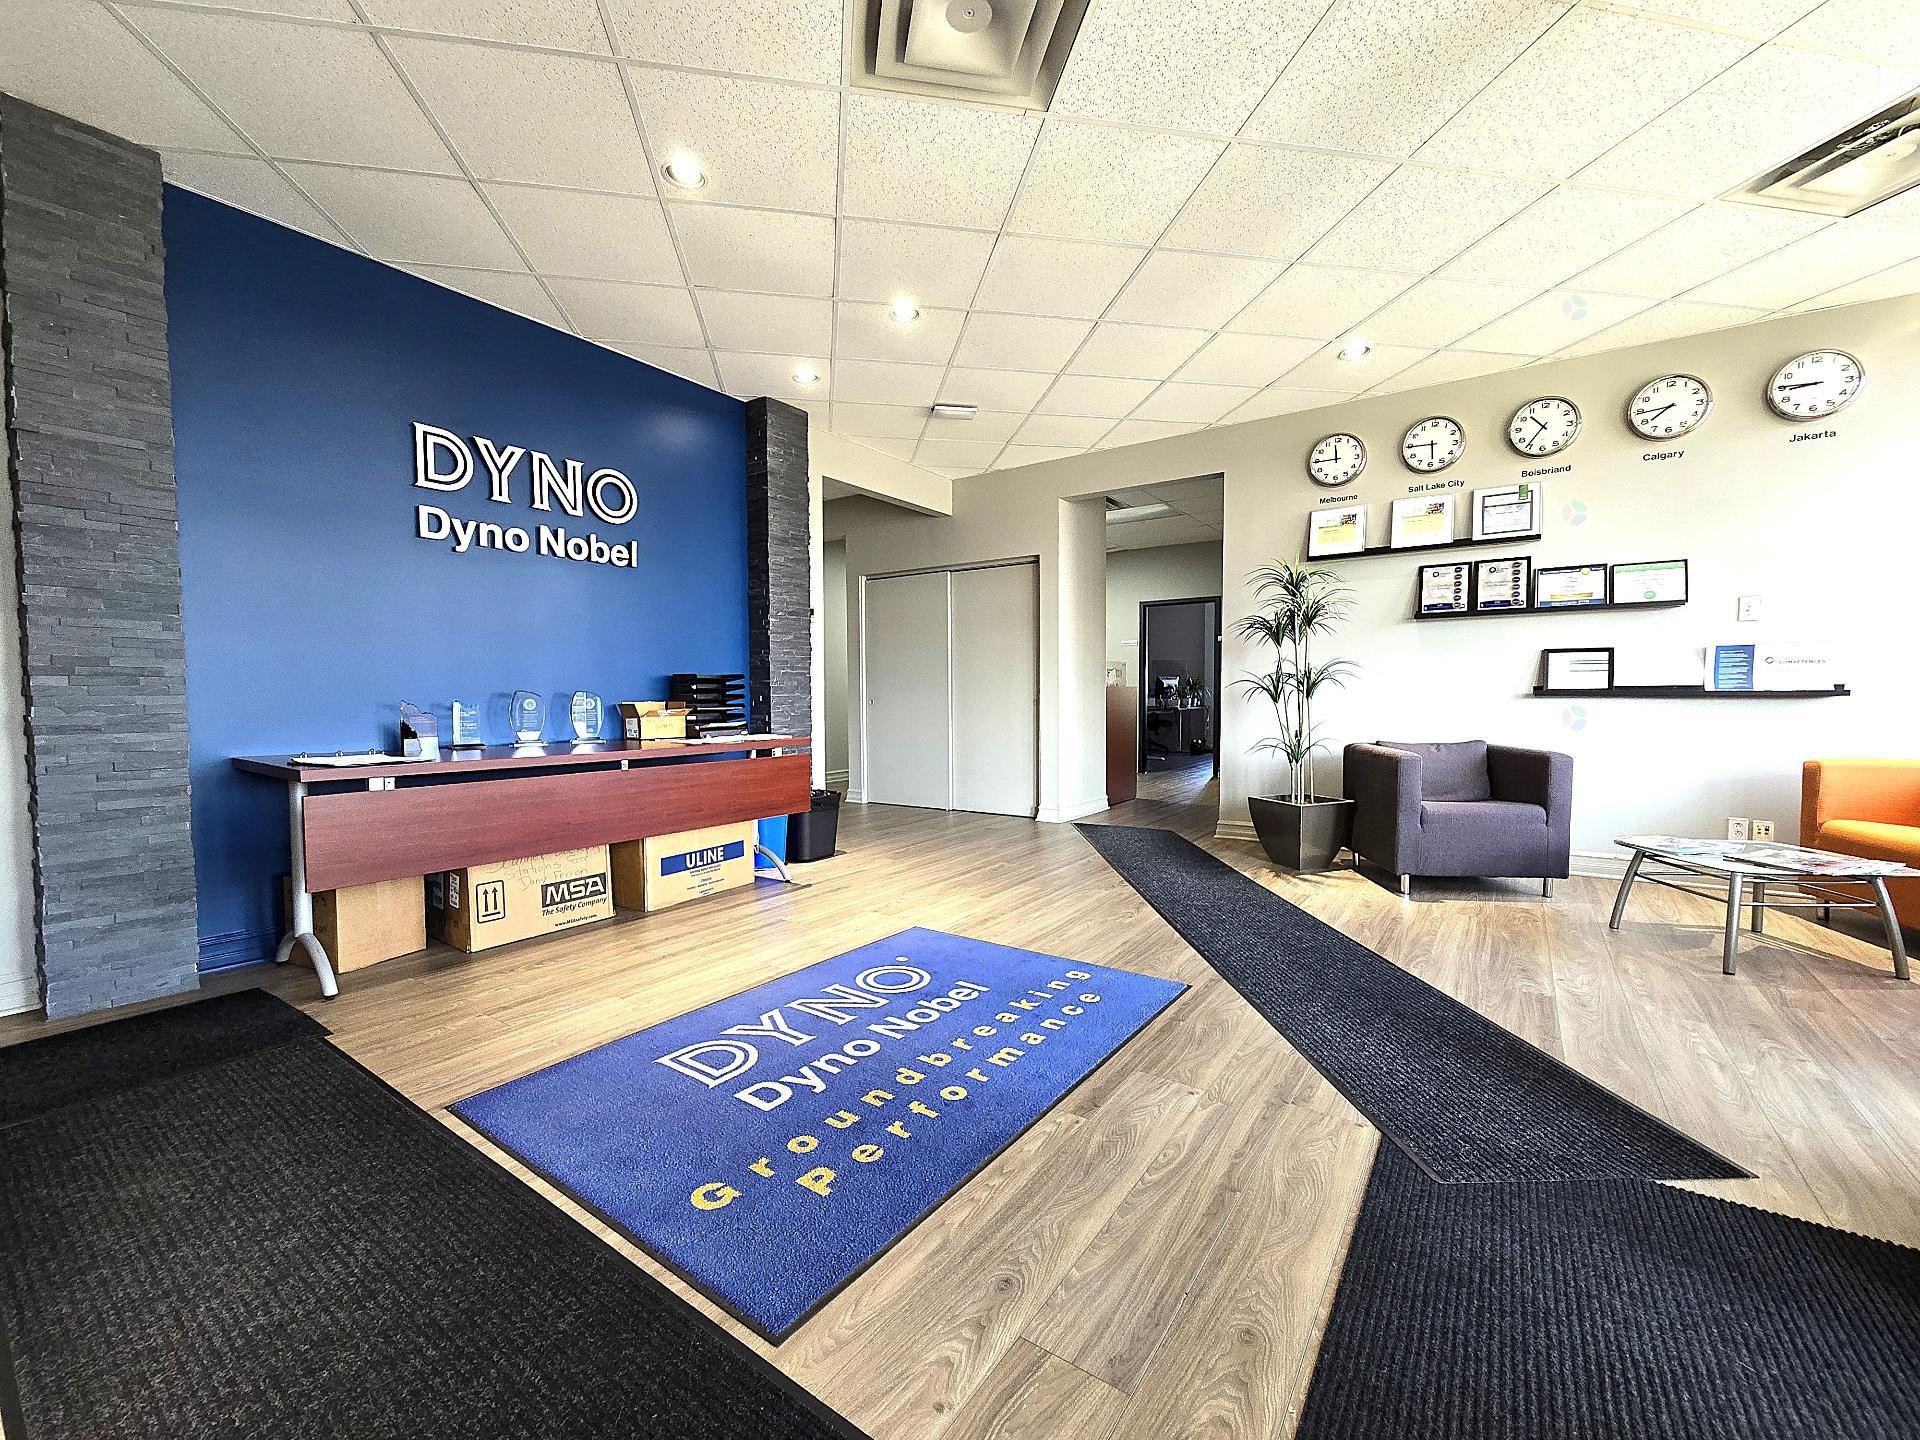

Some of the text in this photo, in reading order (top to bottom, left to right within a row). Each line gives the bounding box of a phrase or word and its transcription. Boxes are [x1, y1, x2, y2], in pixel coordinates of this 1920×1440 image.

[1789, 430, 1837, 442] Jakarta
[1642, 450, 1685, 461] Calgary
[412, 421, 638, 525] DYNO
[1521, 464, 1572, 478] Boisbriand
[1408, 479, 1465, 493] Salt Lake City
[1319, 494, 1358, 504] Melbourne
[417, 504, 638, 568] Dyno Nobel
[685, 846, 724, 868] ULINE
[546, 876, 605, 905] MSA
[542, 896, 607, 917] The Safety Company
[653, 964, 932, 1090] DYNO
[734, 980, 990, 1112] Dyno Nobel
[690, 968, 1092, 1212] Groundbreaking
[795, 992, 1102, 1198] Performance
